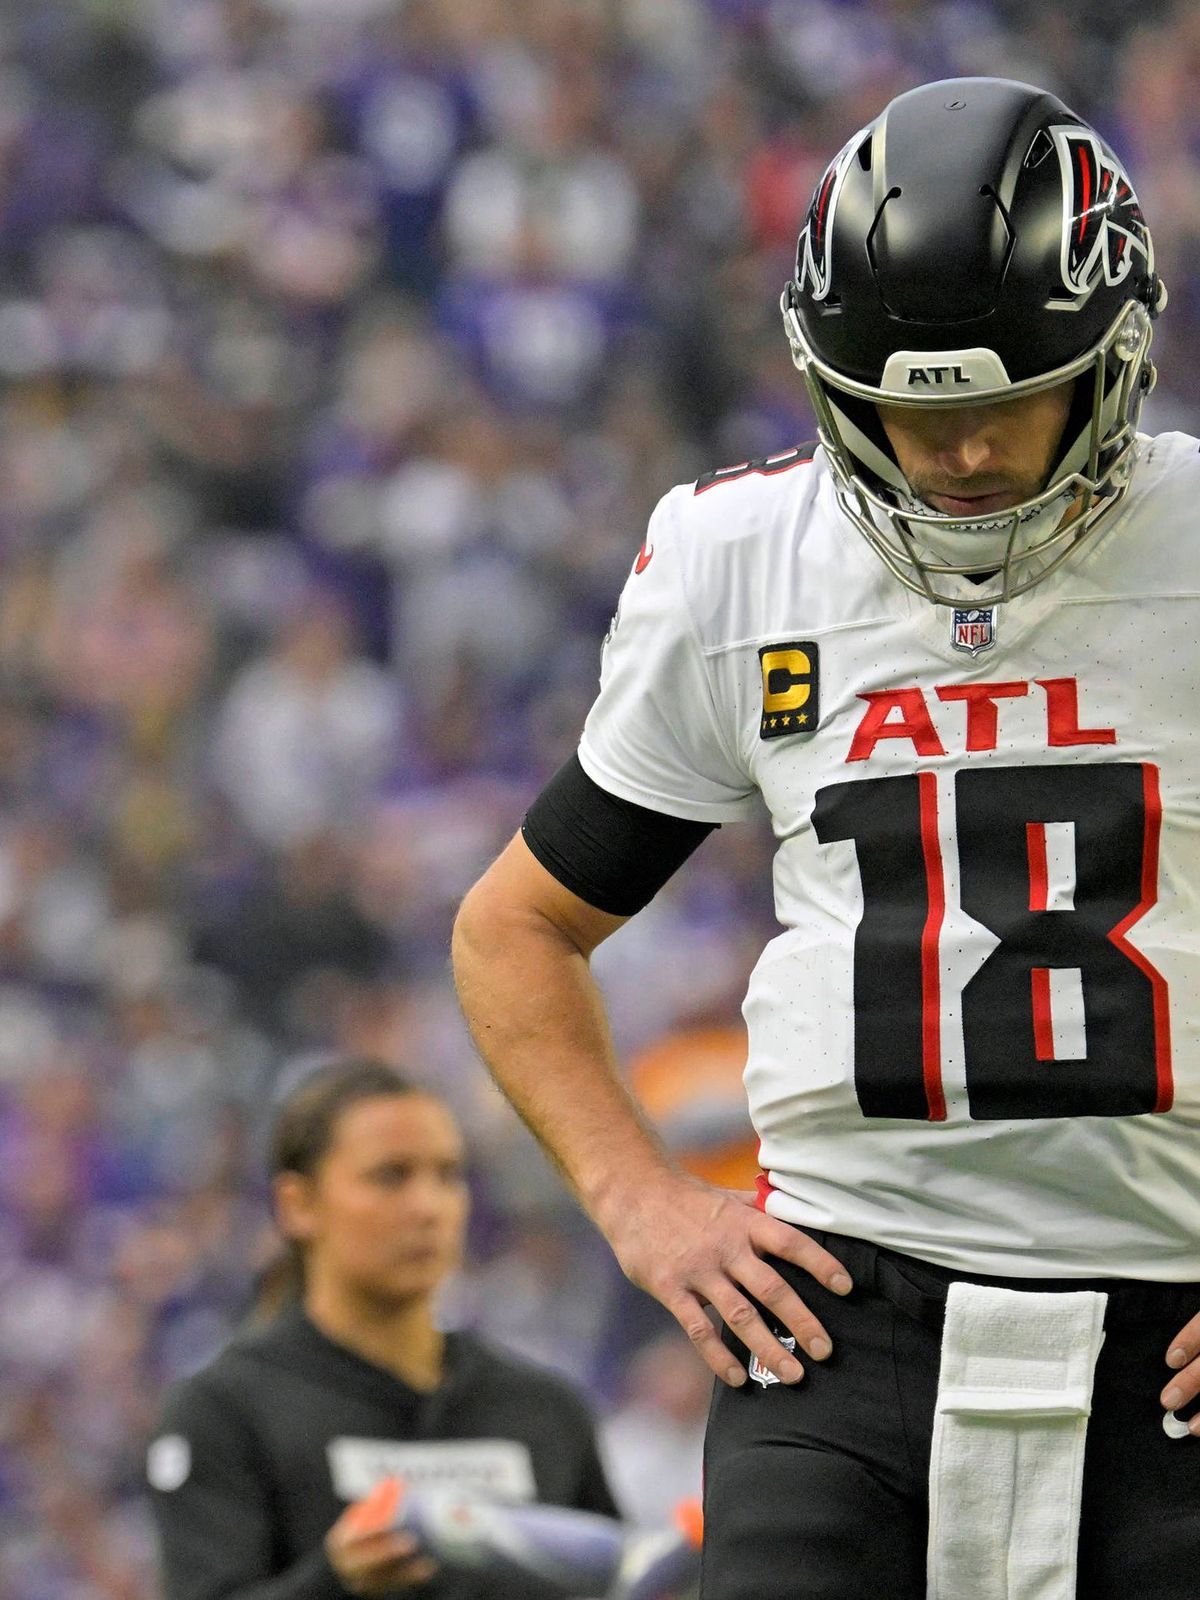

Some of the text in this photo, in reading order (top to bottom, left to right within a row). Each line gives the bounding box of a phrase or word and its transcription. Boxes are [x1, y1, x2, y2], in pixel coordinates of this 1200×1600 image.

[907, 366, 971, 385] ATL
[958, 625, 989, 646] NFL
[761, 650, 811, 713] C
[845, 677, 1116, 763] ATL
[810, 762, 1174, 1121] 18
